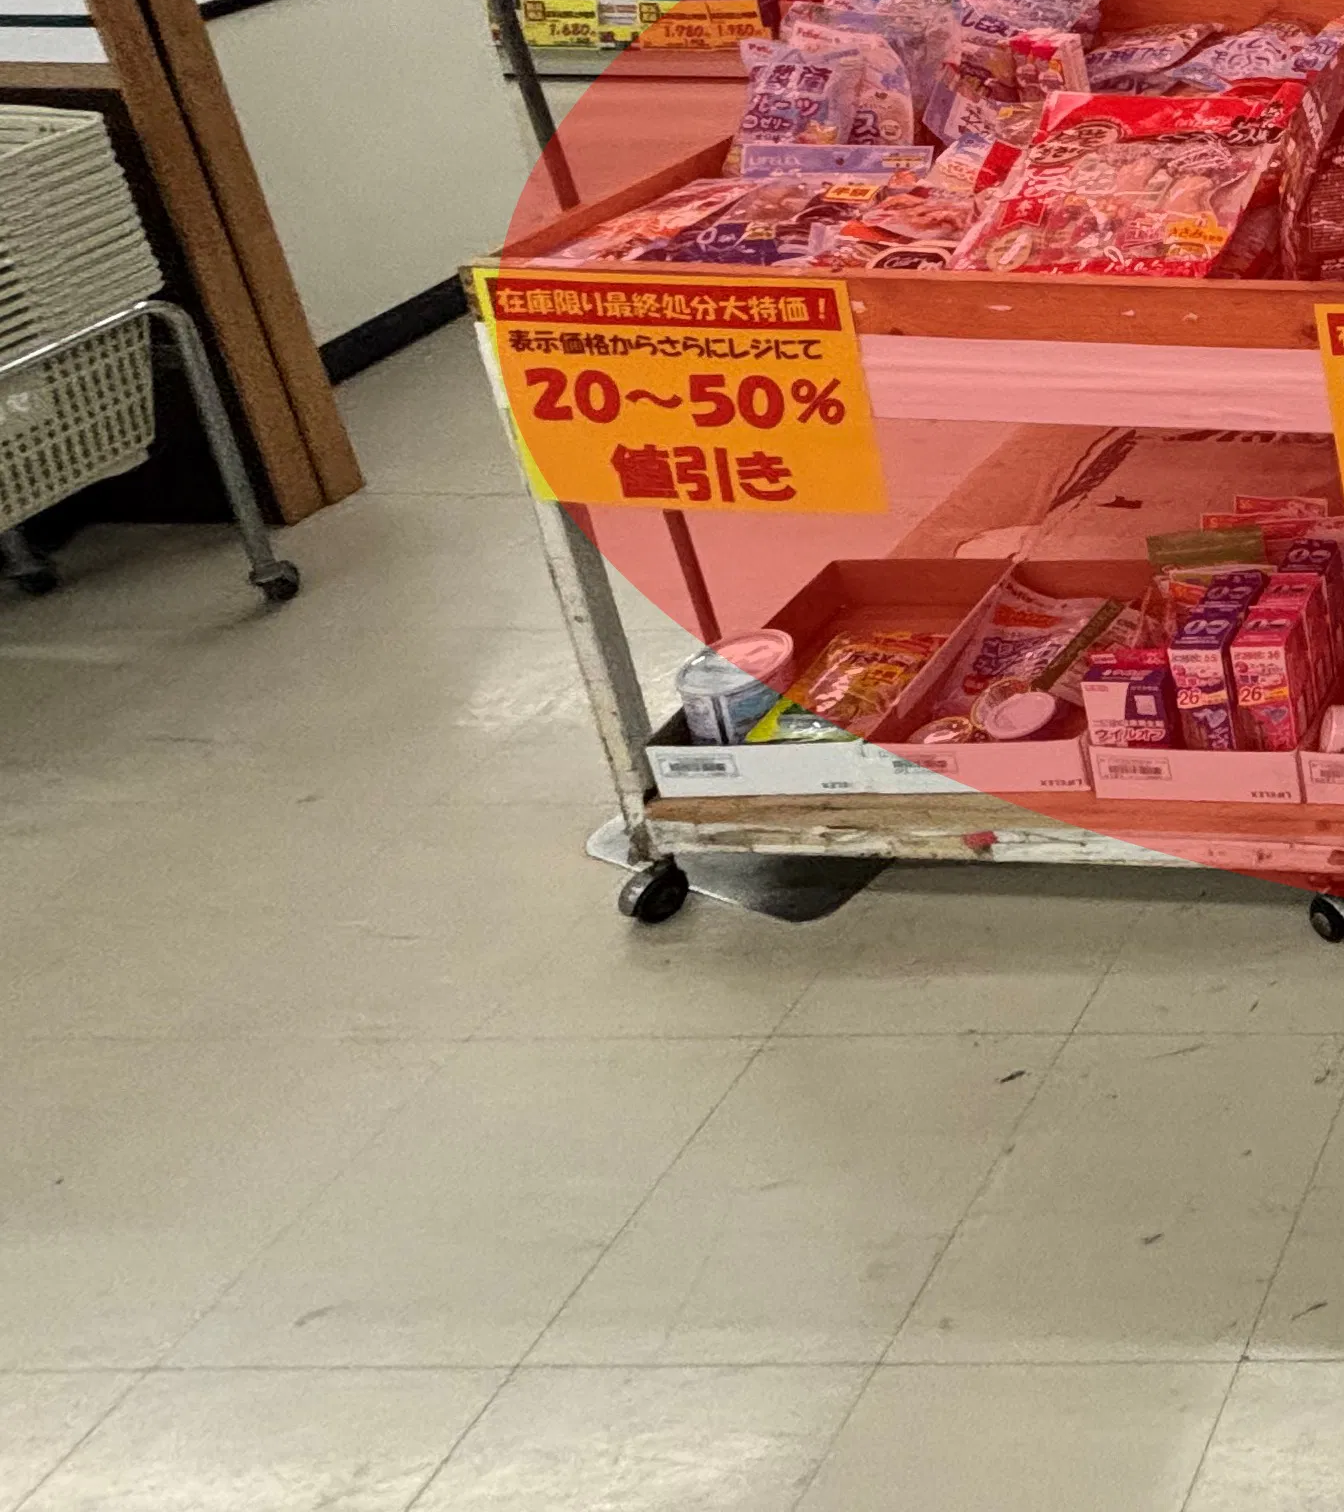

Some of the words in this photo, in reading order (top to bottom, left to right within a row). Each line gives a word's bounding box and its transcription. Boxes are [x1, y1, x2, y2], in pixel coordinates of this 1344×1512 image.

[508, 329, 822, 361] 表示価格からさらにレジにて
[610, 442, 797, 503] 値引き
